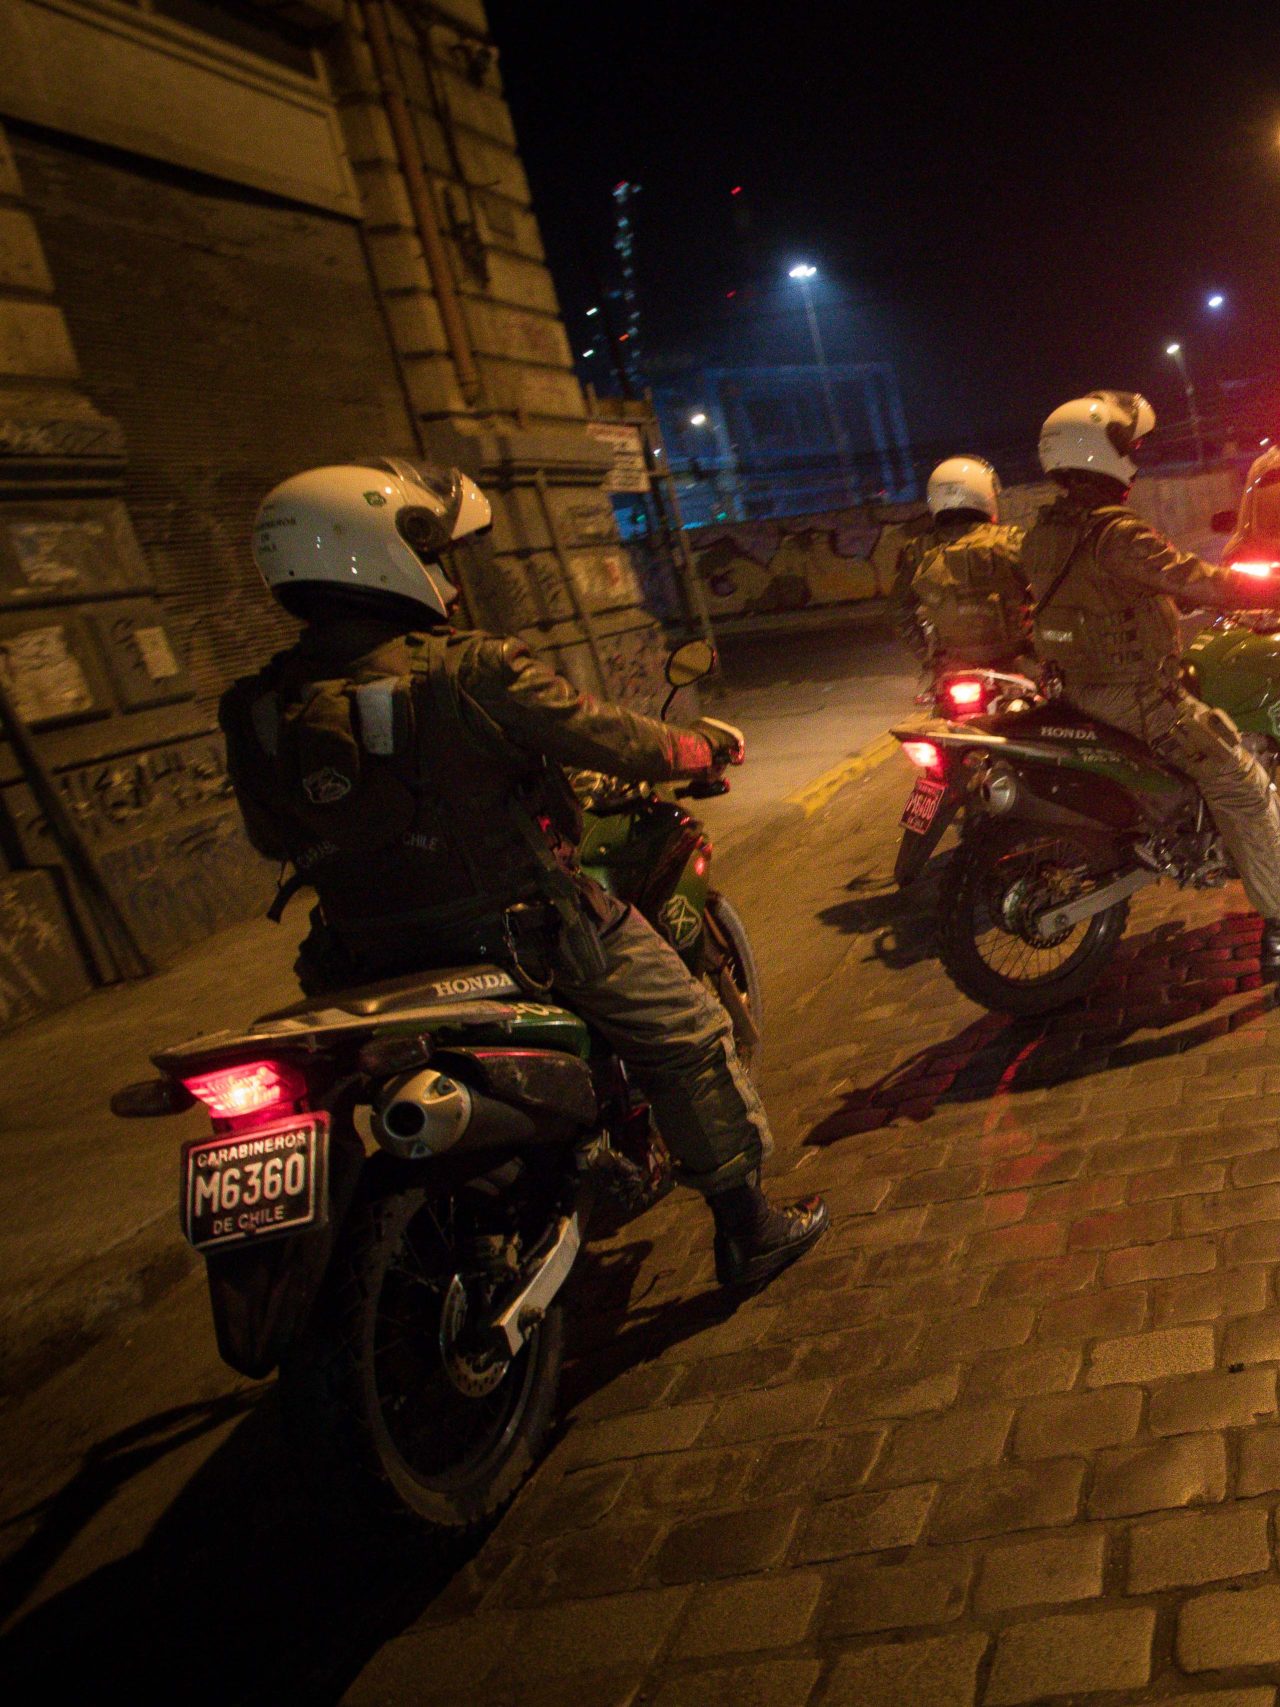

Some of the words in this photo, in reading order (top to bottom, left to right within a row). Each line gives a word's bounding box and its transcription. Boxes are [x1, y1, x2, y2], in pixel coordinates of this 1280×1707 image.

[1040, 726, 1098, 741] HONDA
[431, 973, 514, 997] HONDA
[197, 1132, 306, 1168] CARABINEROS
[195, 1152, 305, 1217] M6360
[213, 1216, 233, 1235] DE
[238, 1205, 285, 1229] CHILE
